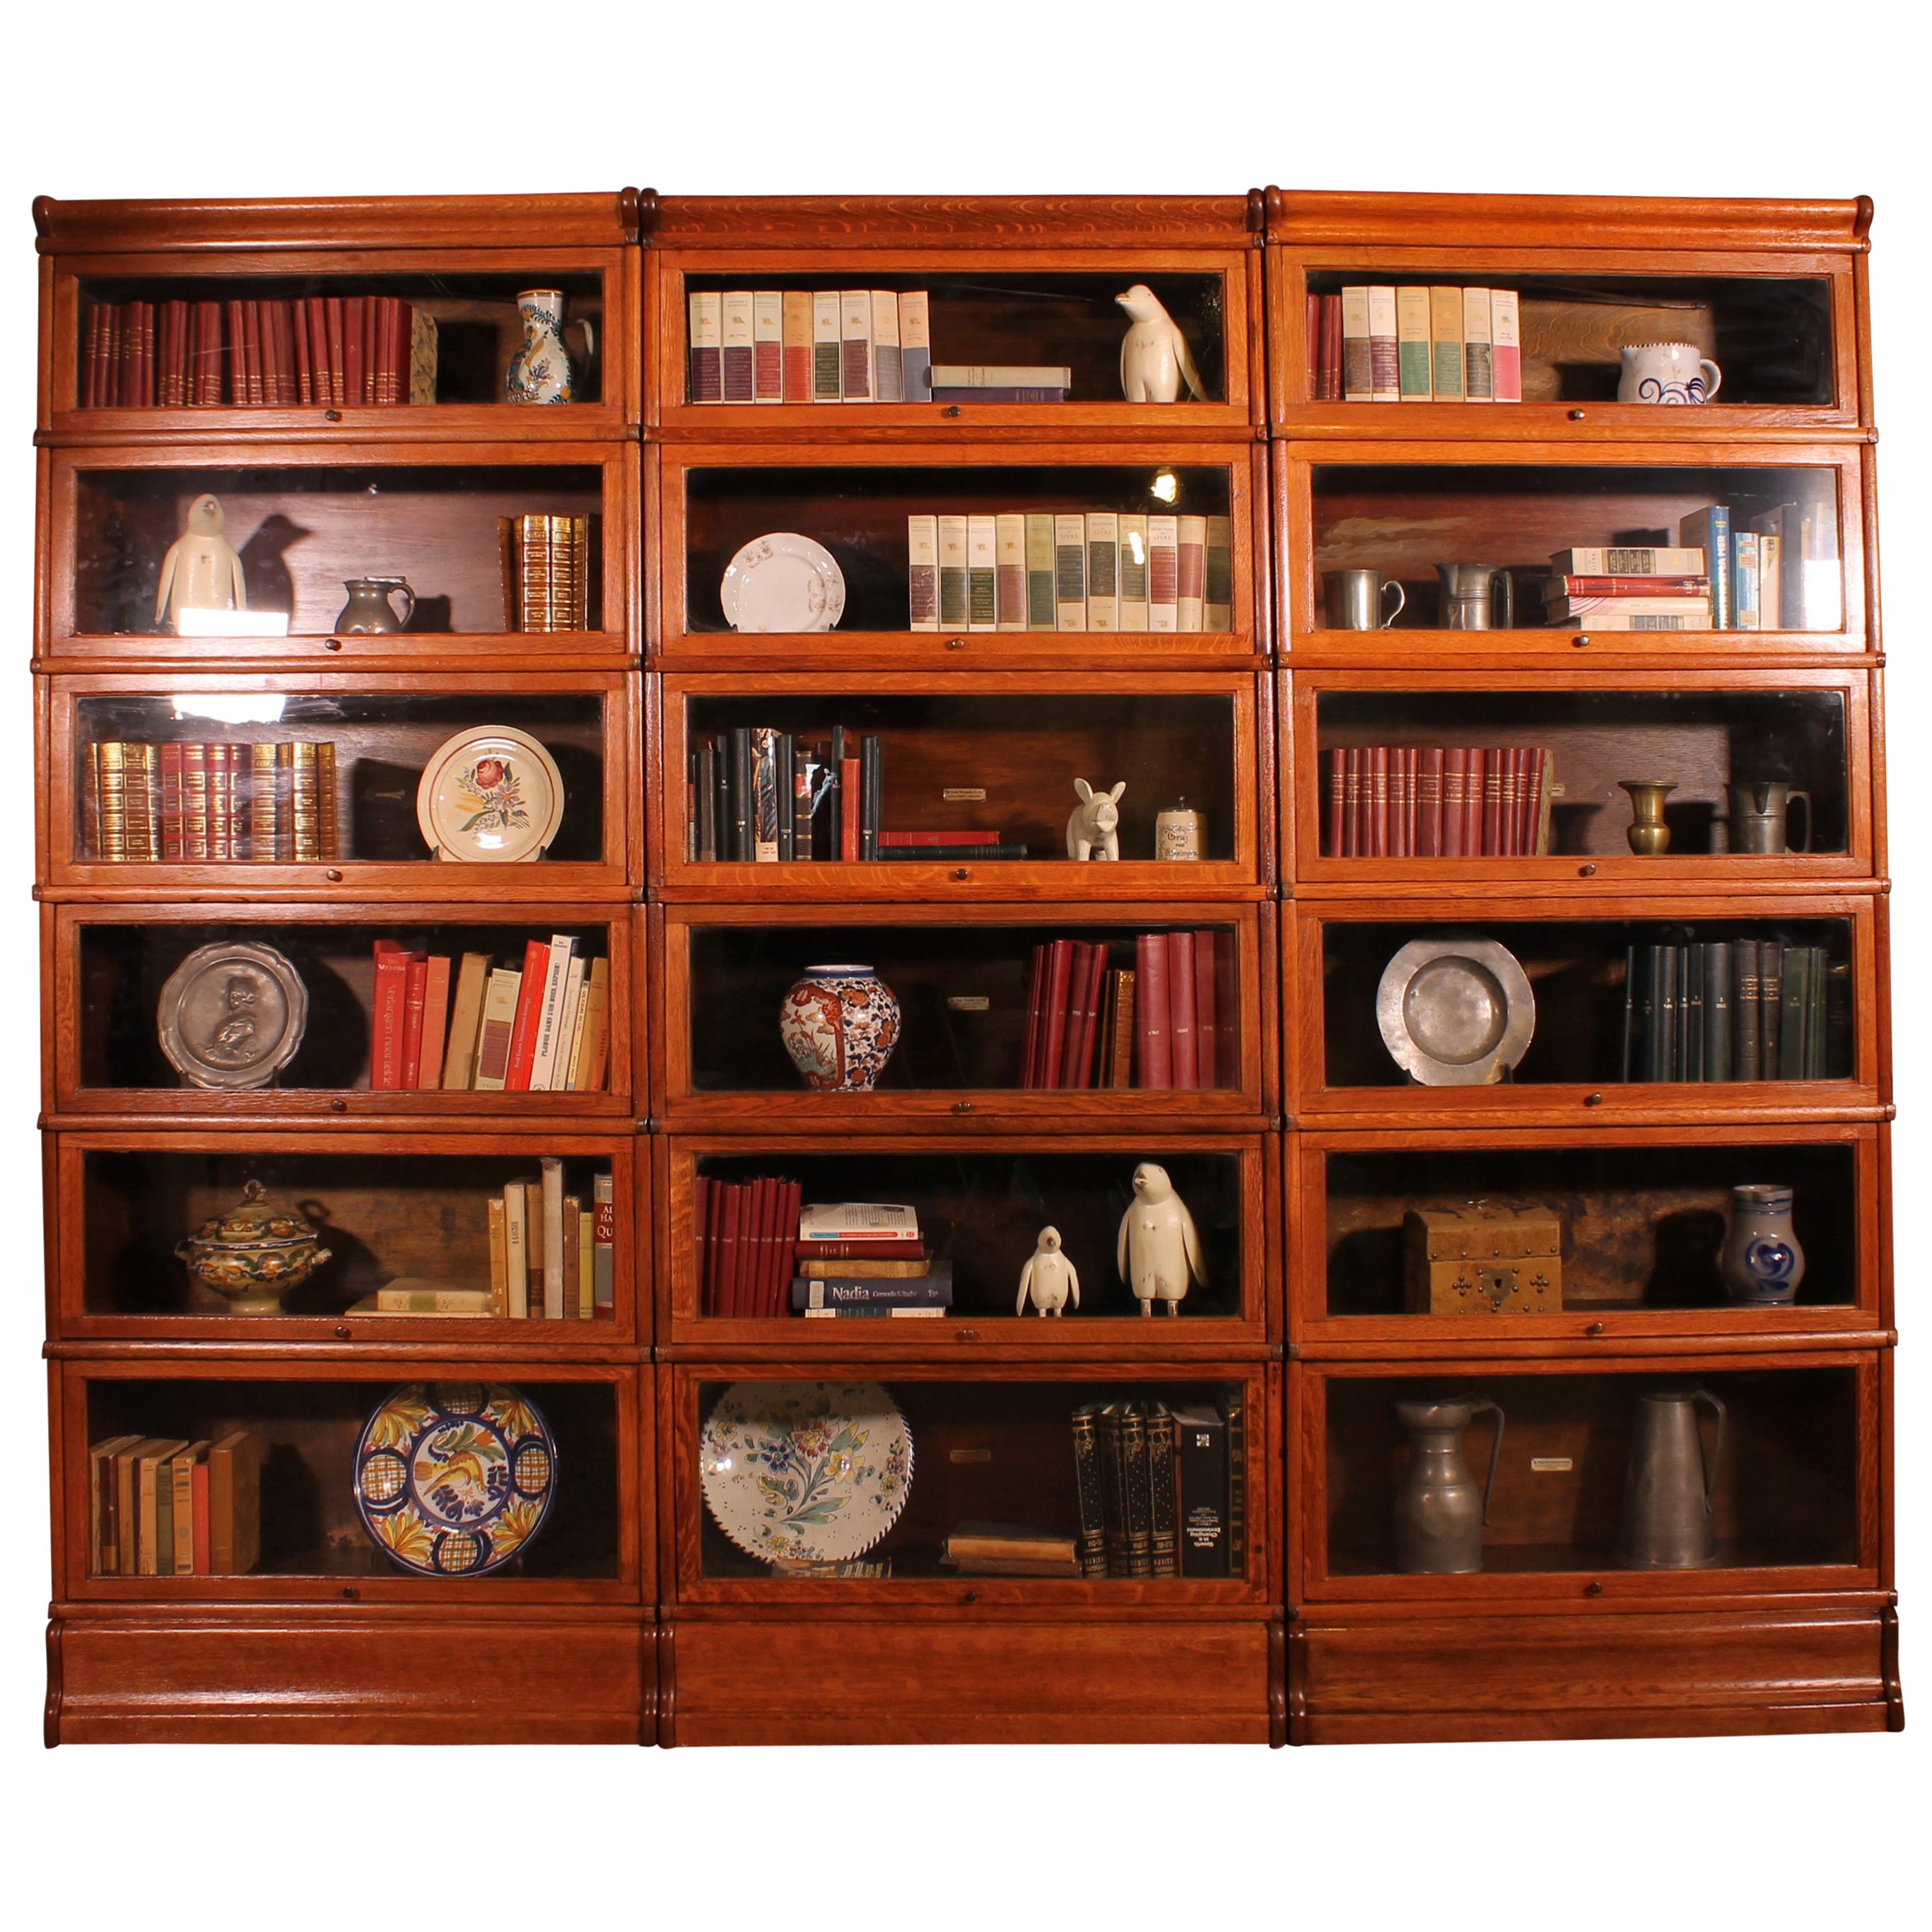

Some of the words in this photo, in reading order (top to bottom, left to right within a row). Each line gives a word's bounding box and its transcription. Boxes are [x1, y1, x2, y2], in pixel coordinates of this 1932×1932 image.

[382, 985, 397, 1034] Verlangen
[517, 1017, 527, 1042] Investment
[543, 1017, 553, 1033] DANS
[540, 1034, 551, 1058] PLONGE
[382, 1060, 394, 1087] liefde
[832, 1286, 870, 1301] Nadia
